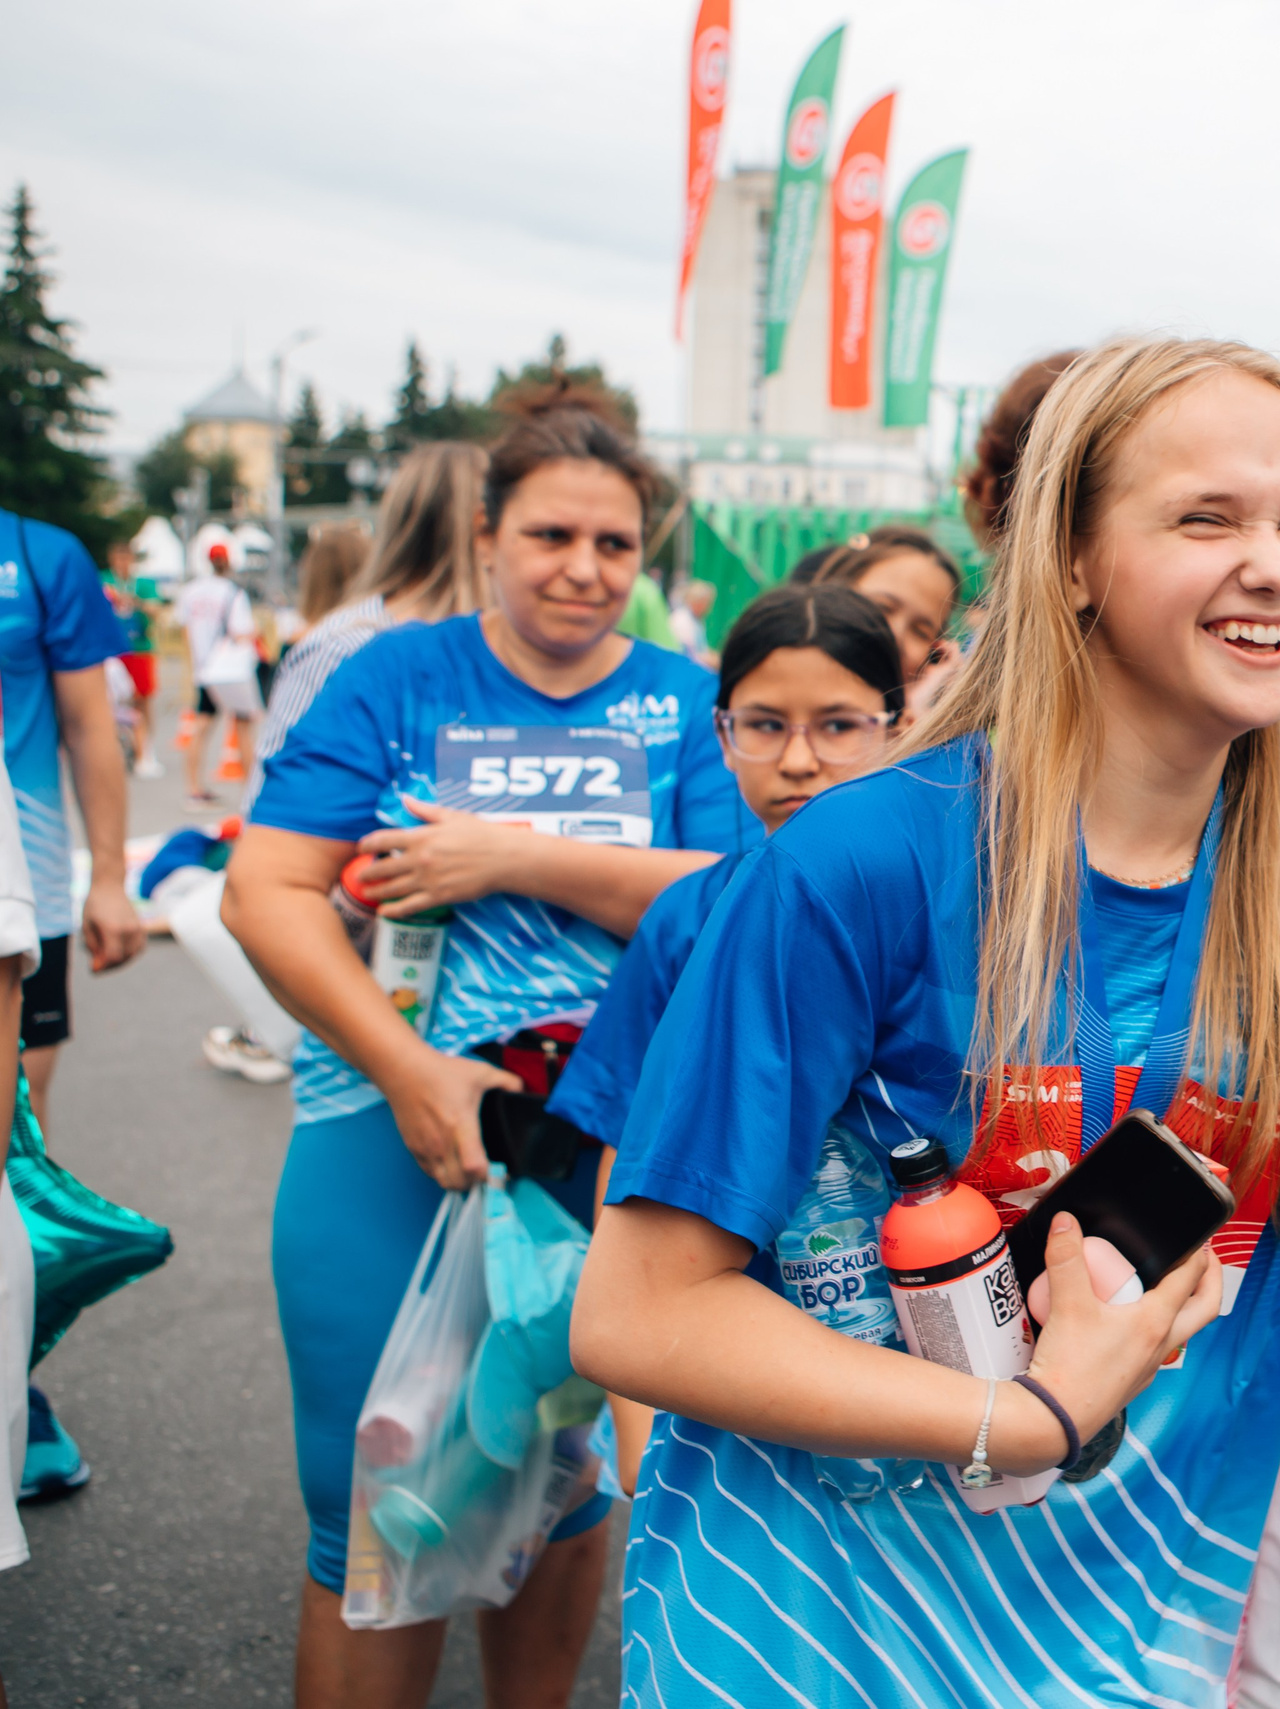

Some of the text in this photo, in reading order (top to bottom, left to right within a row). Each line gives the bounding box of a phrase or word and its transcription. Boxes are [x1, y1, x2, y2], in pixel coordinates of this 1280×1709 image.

[469, 756, 623, 797] 5572
[782, 1245, 880, 1282] СИБИРСКИЙ
[800, 1276, 863, 1312] БОР
